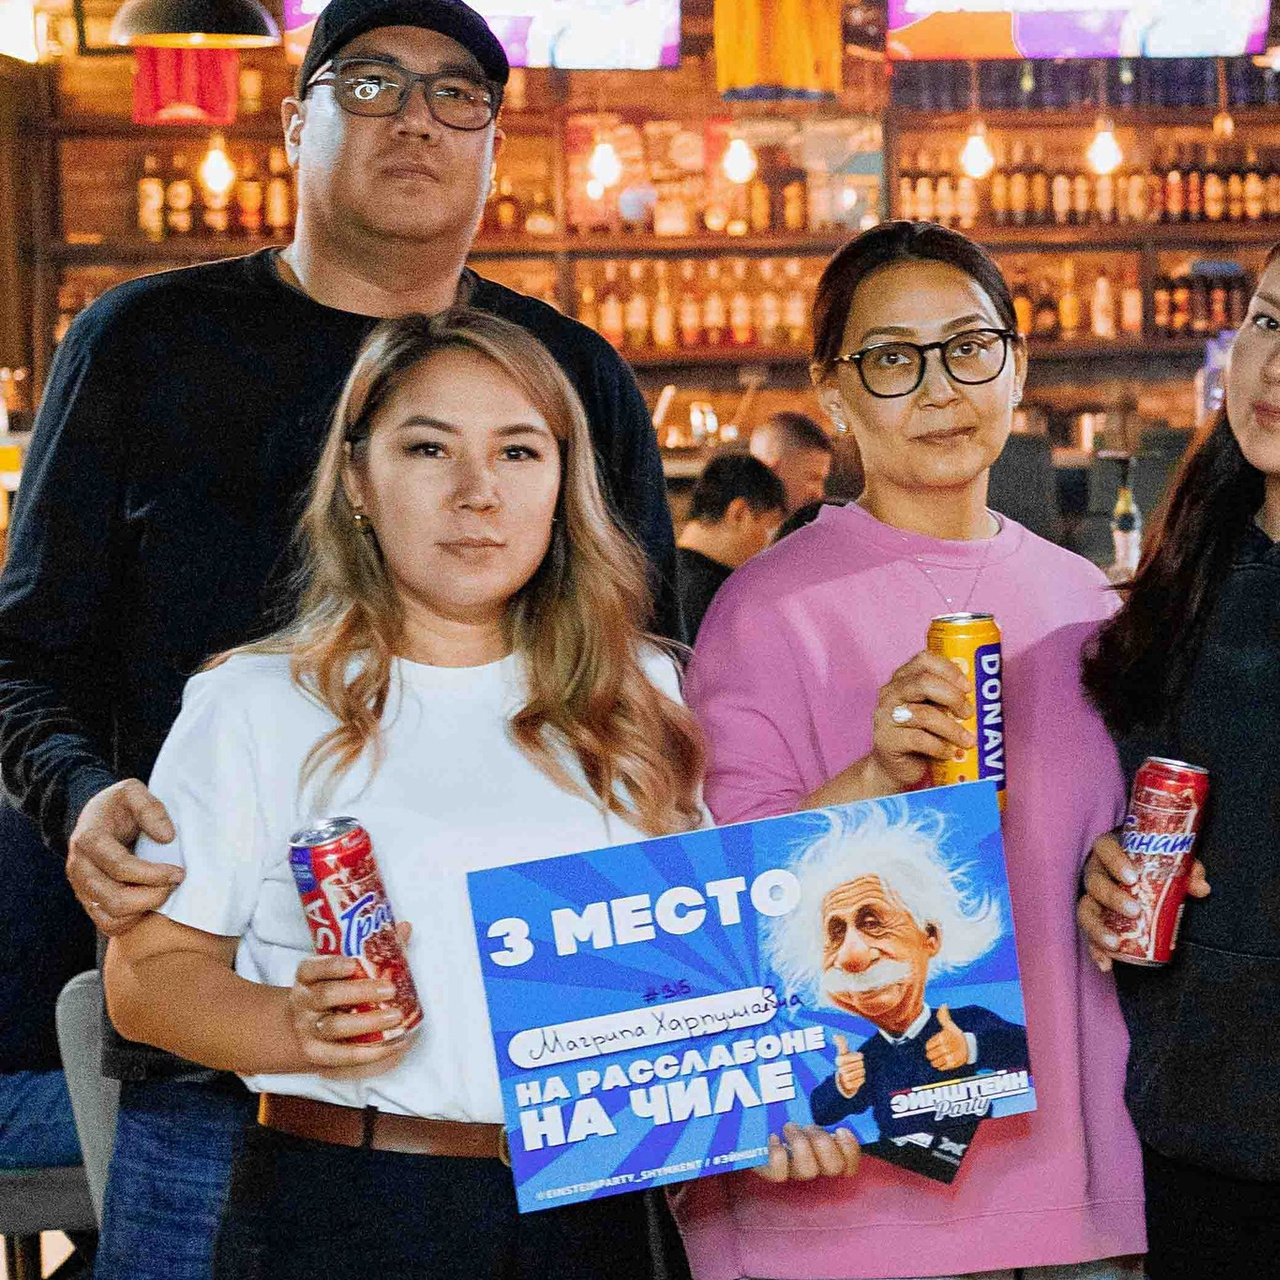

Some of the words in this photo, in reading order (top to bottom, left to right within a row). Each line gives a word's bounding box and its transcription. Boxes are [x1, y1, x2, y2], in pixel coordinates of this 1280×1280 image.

[487, 917, 535, 967] 3
[551, 868, 800, 956] МЕСТО
[515, 1076, 572, 1108] НА
[576, 1026, 826, 1095] РАССЛАБОНЕ
[520, 1097, 617, 1152] НА
[630, 1060, 796, 1126] ЧИЛЕ
